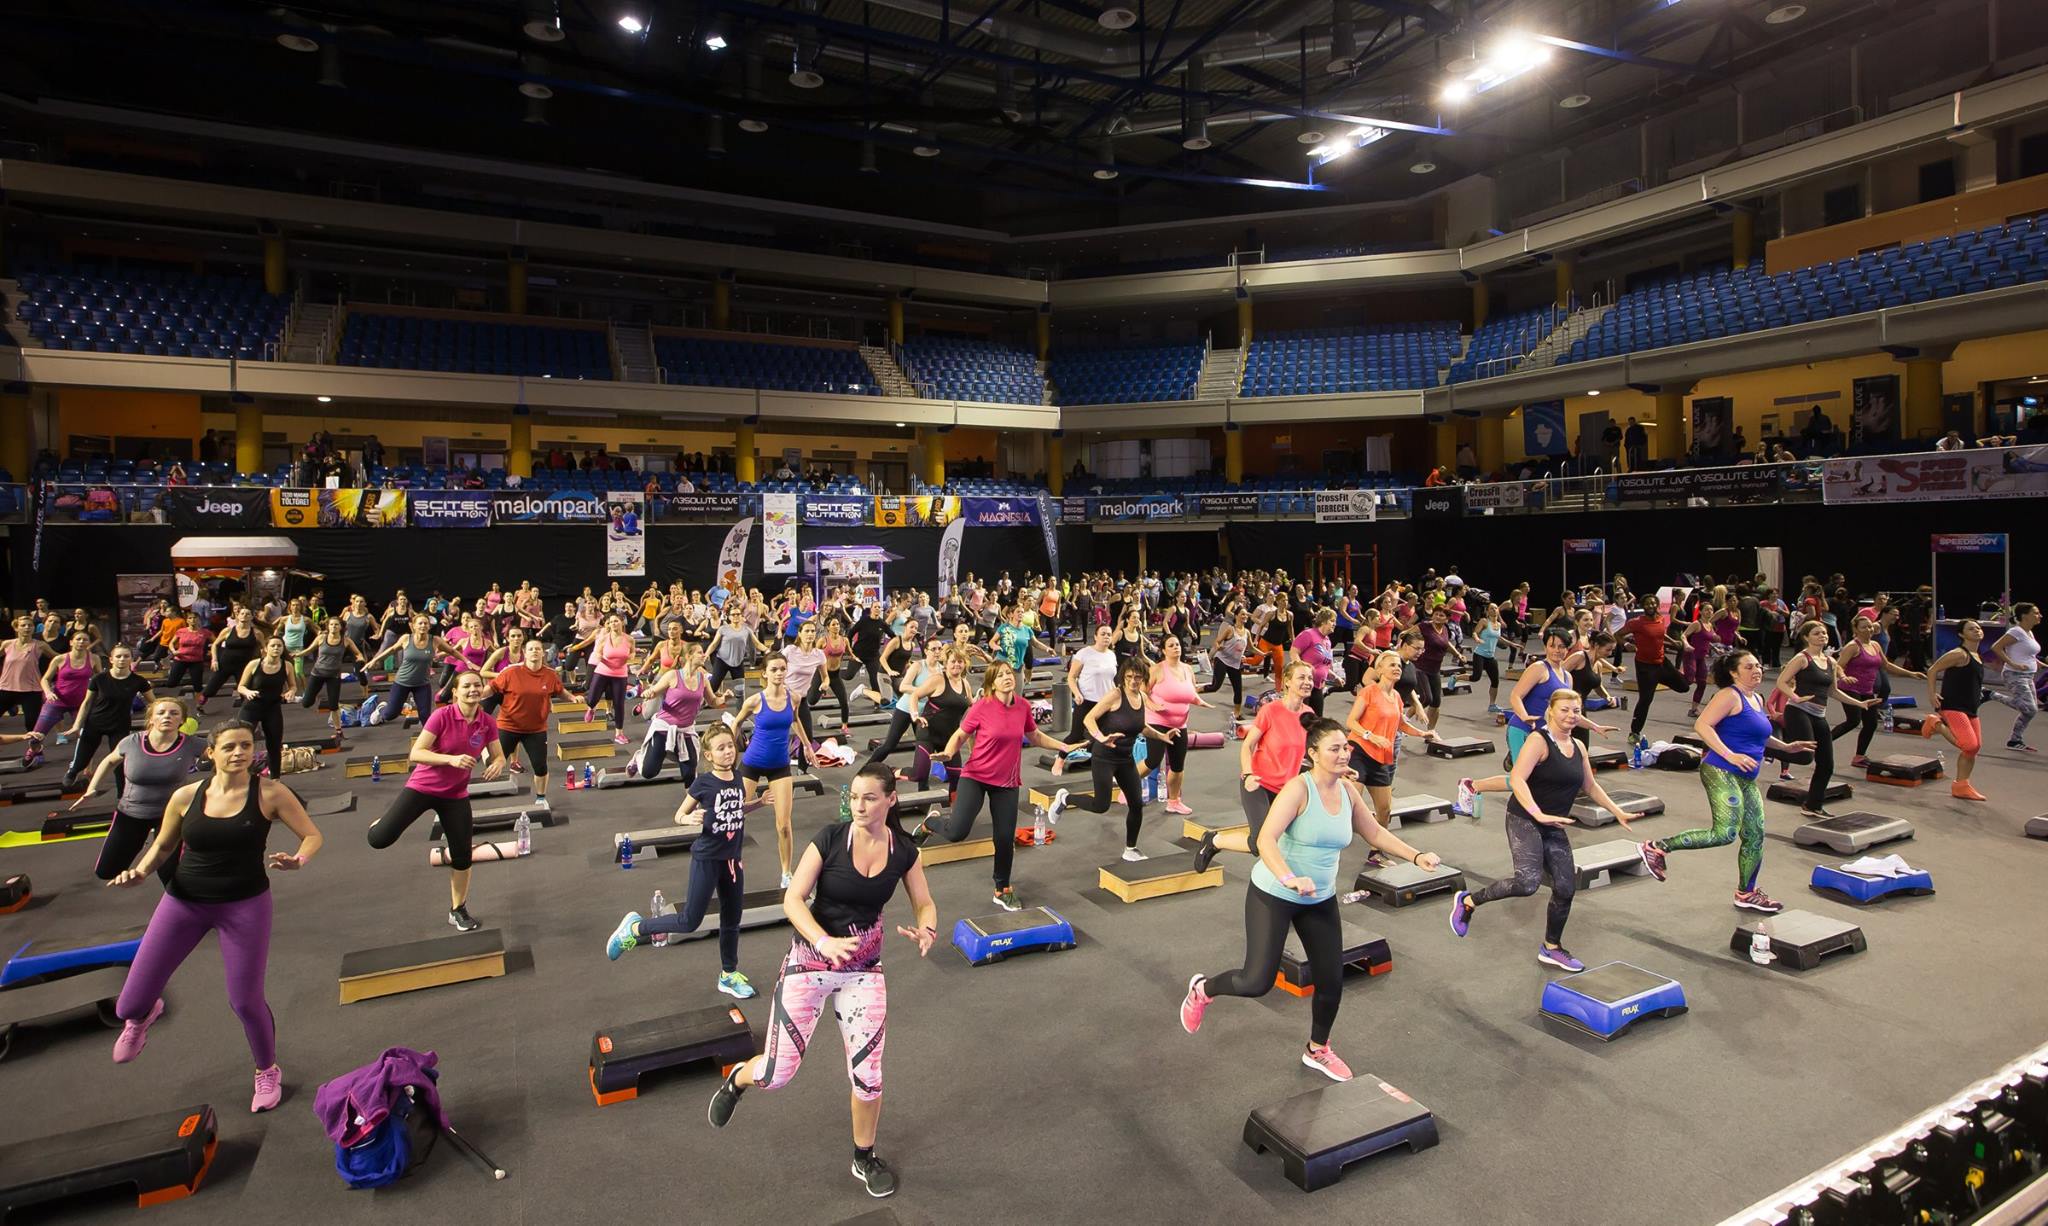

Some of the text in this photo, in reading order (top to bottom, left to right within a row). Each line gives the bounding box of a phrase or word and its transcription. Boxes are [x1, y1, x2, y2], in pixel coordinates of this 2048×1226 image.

[1754, 469, 1777, 479] LIVE
[1669, 475, 1691, 485] LIVE
[1469, 486, 1500, 498] CrossFit
[720, 496, 739, 505] LIVE
[1241, 496, 1258, 504] LIVE
[1316, 493, 1349, 503] CrossFit
[196, 499, 243, 516] Jeep
[413, 500, 489, 510] SCITEC
[494, 495, 606, 518] malompark
[805, 502, 863, 512] SCITEC
[1100, 499, 1184, 518] malompark
[1316, 503, 1350, 513] DEBRECEN
[1425, 499, 1450, 512] Jeep
[414, 510, 489, 519] NUTRITION
[805, 511, 862, 519] NUTRITION
[979, 511, 1031, 523] MAGNESIA
[1939, 536, 1998, 546] SPEEDBODY
[720, 787, 739, 800] you
